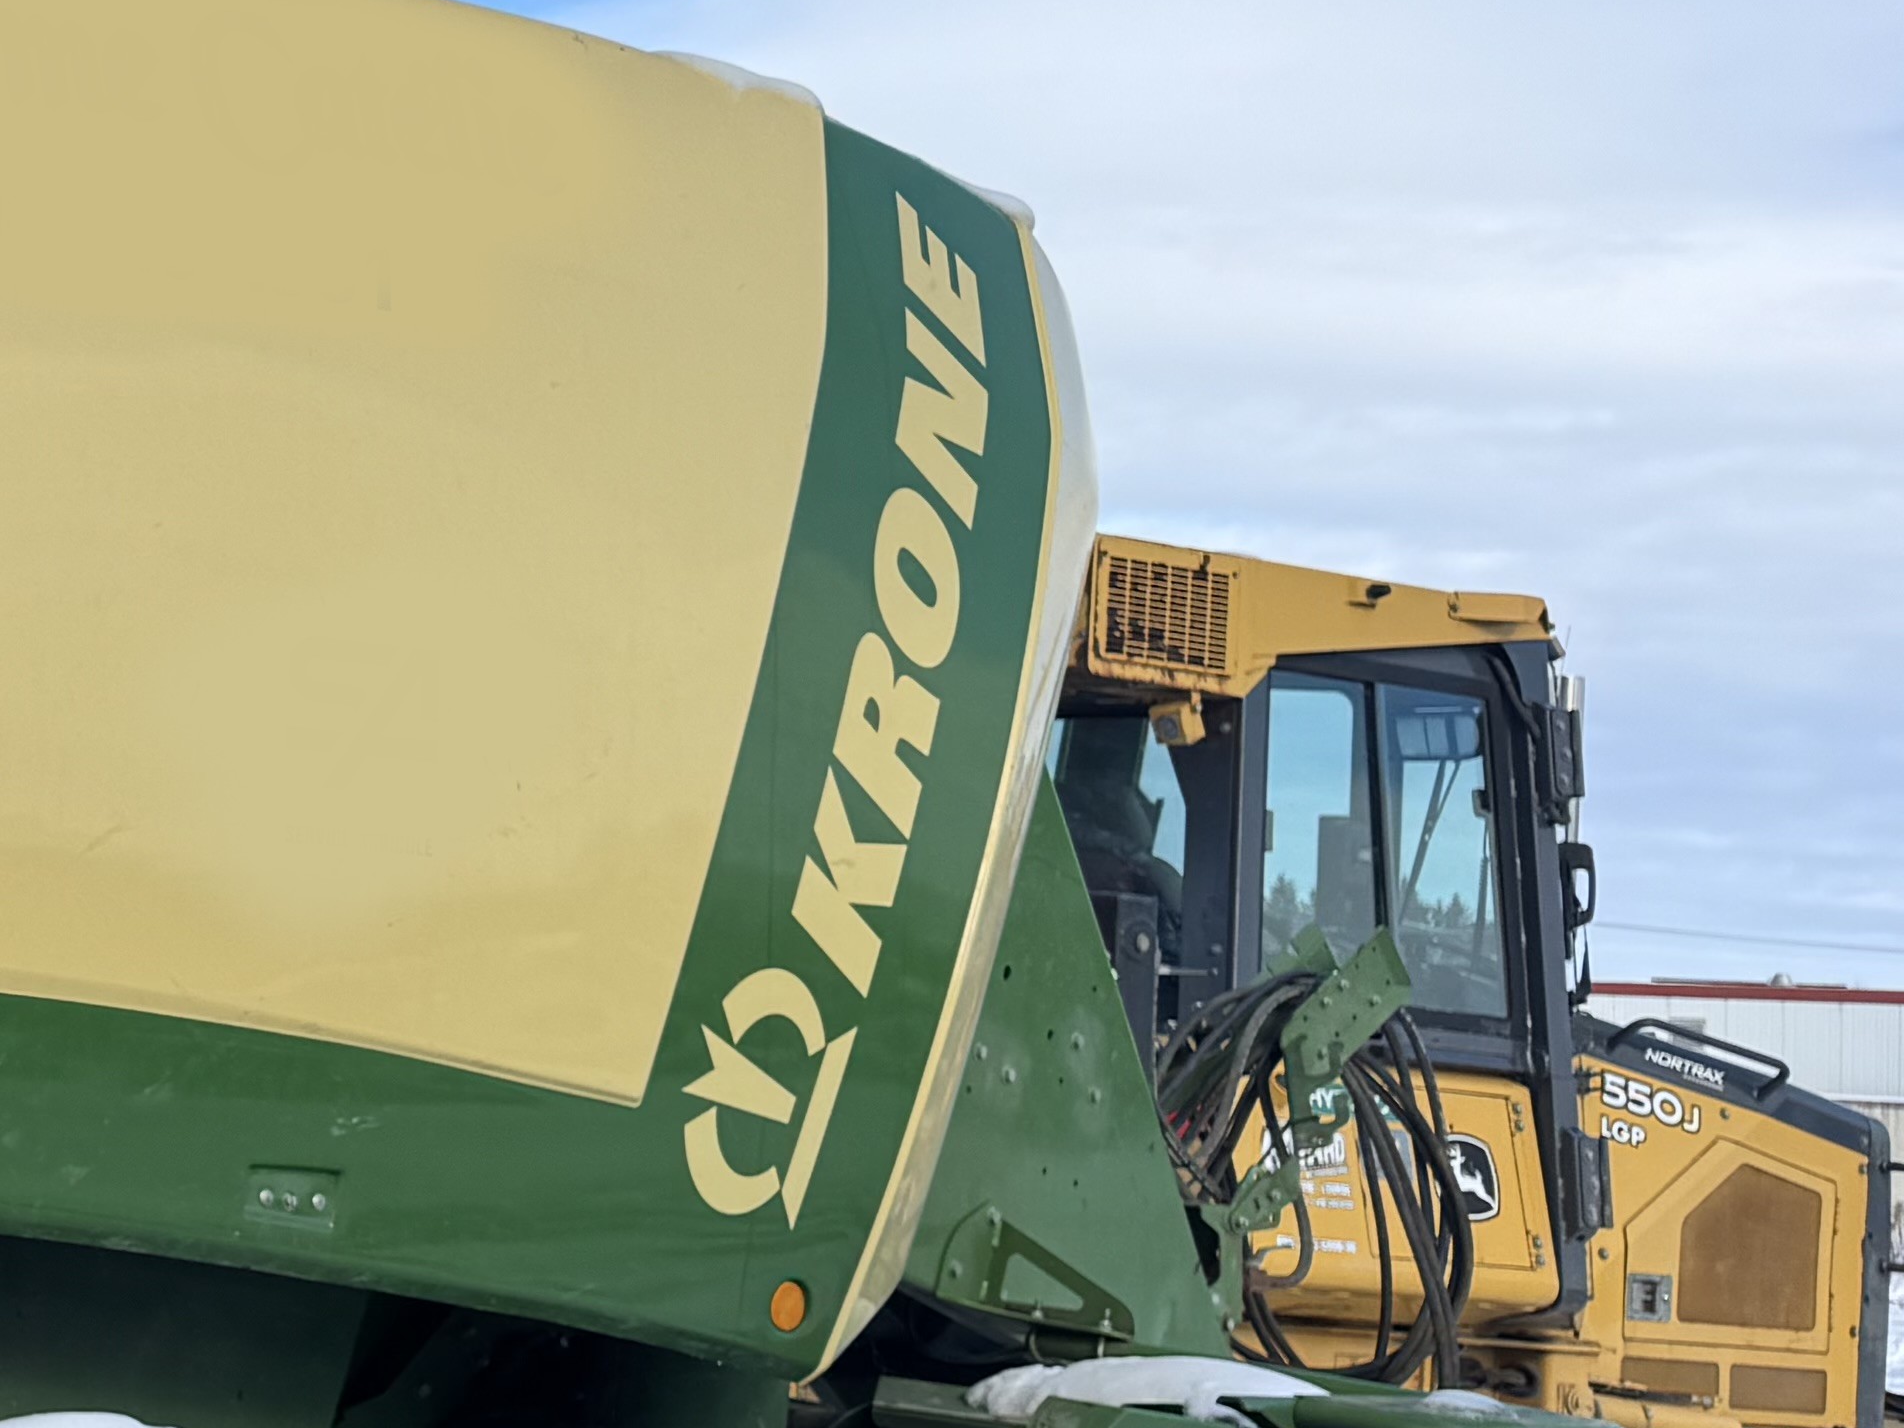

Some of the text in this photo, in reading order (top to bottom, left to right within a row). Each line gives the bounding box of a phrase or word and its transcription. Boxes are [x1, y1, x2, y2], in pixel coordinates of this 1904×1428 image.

[792, 191, 989, 998] KRONE
[1645, 1047, 1725, 1085] NORTRAX
[1602, 1072, 1700, 1133] 550J
[1601, 1116, 1646, 1147] LGP
